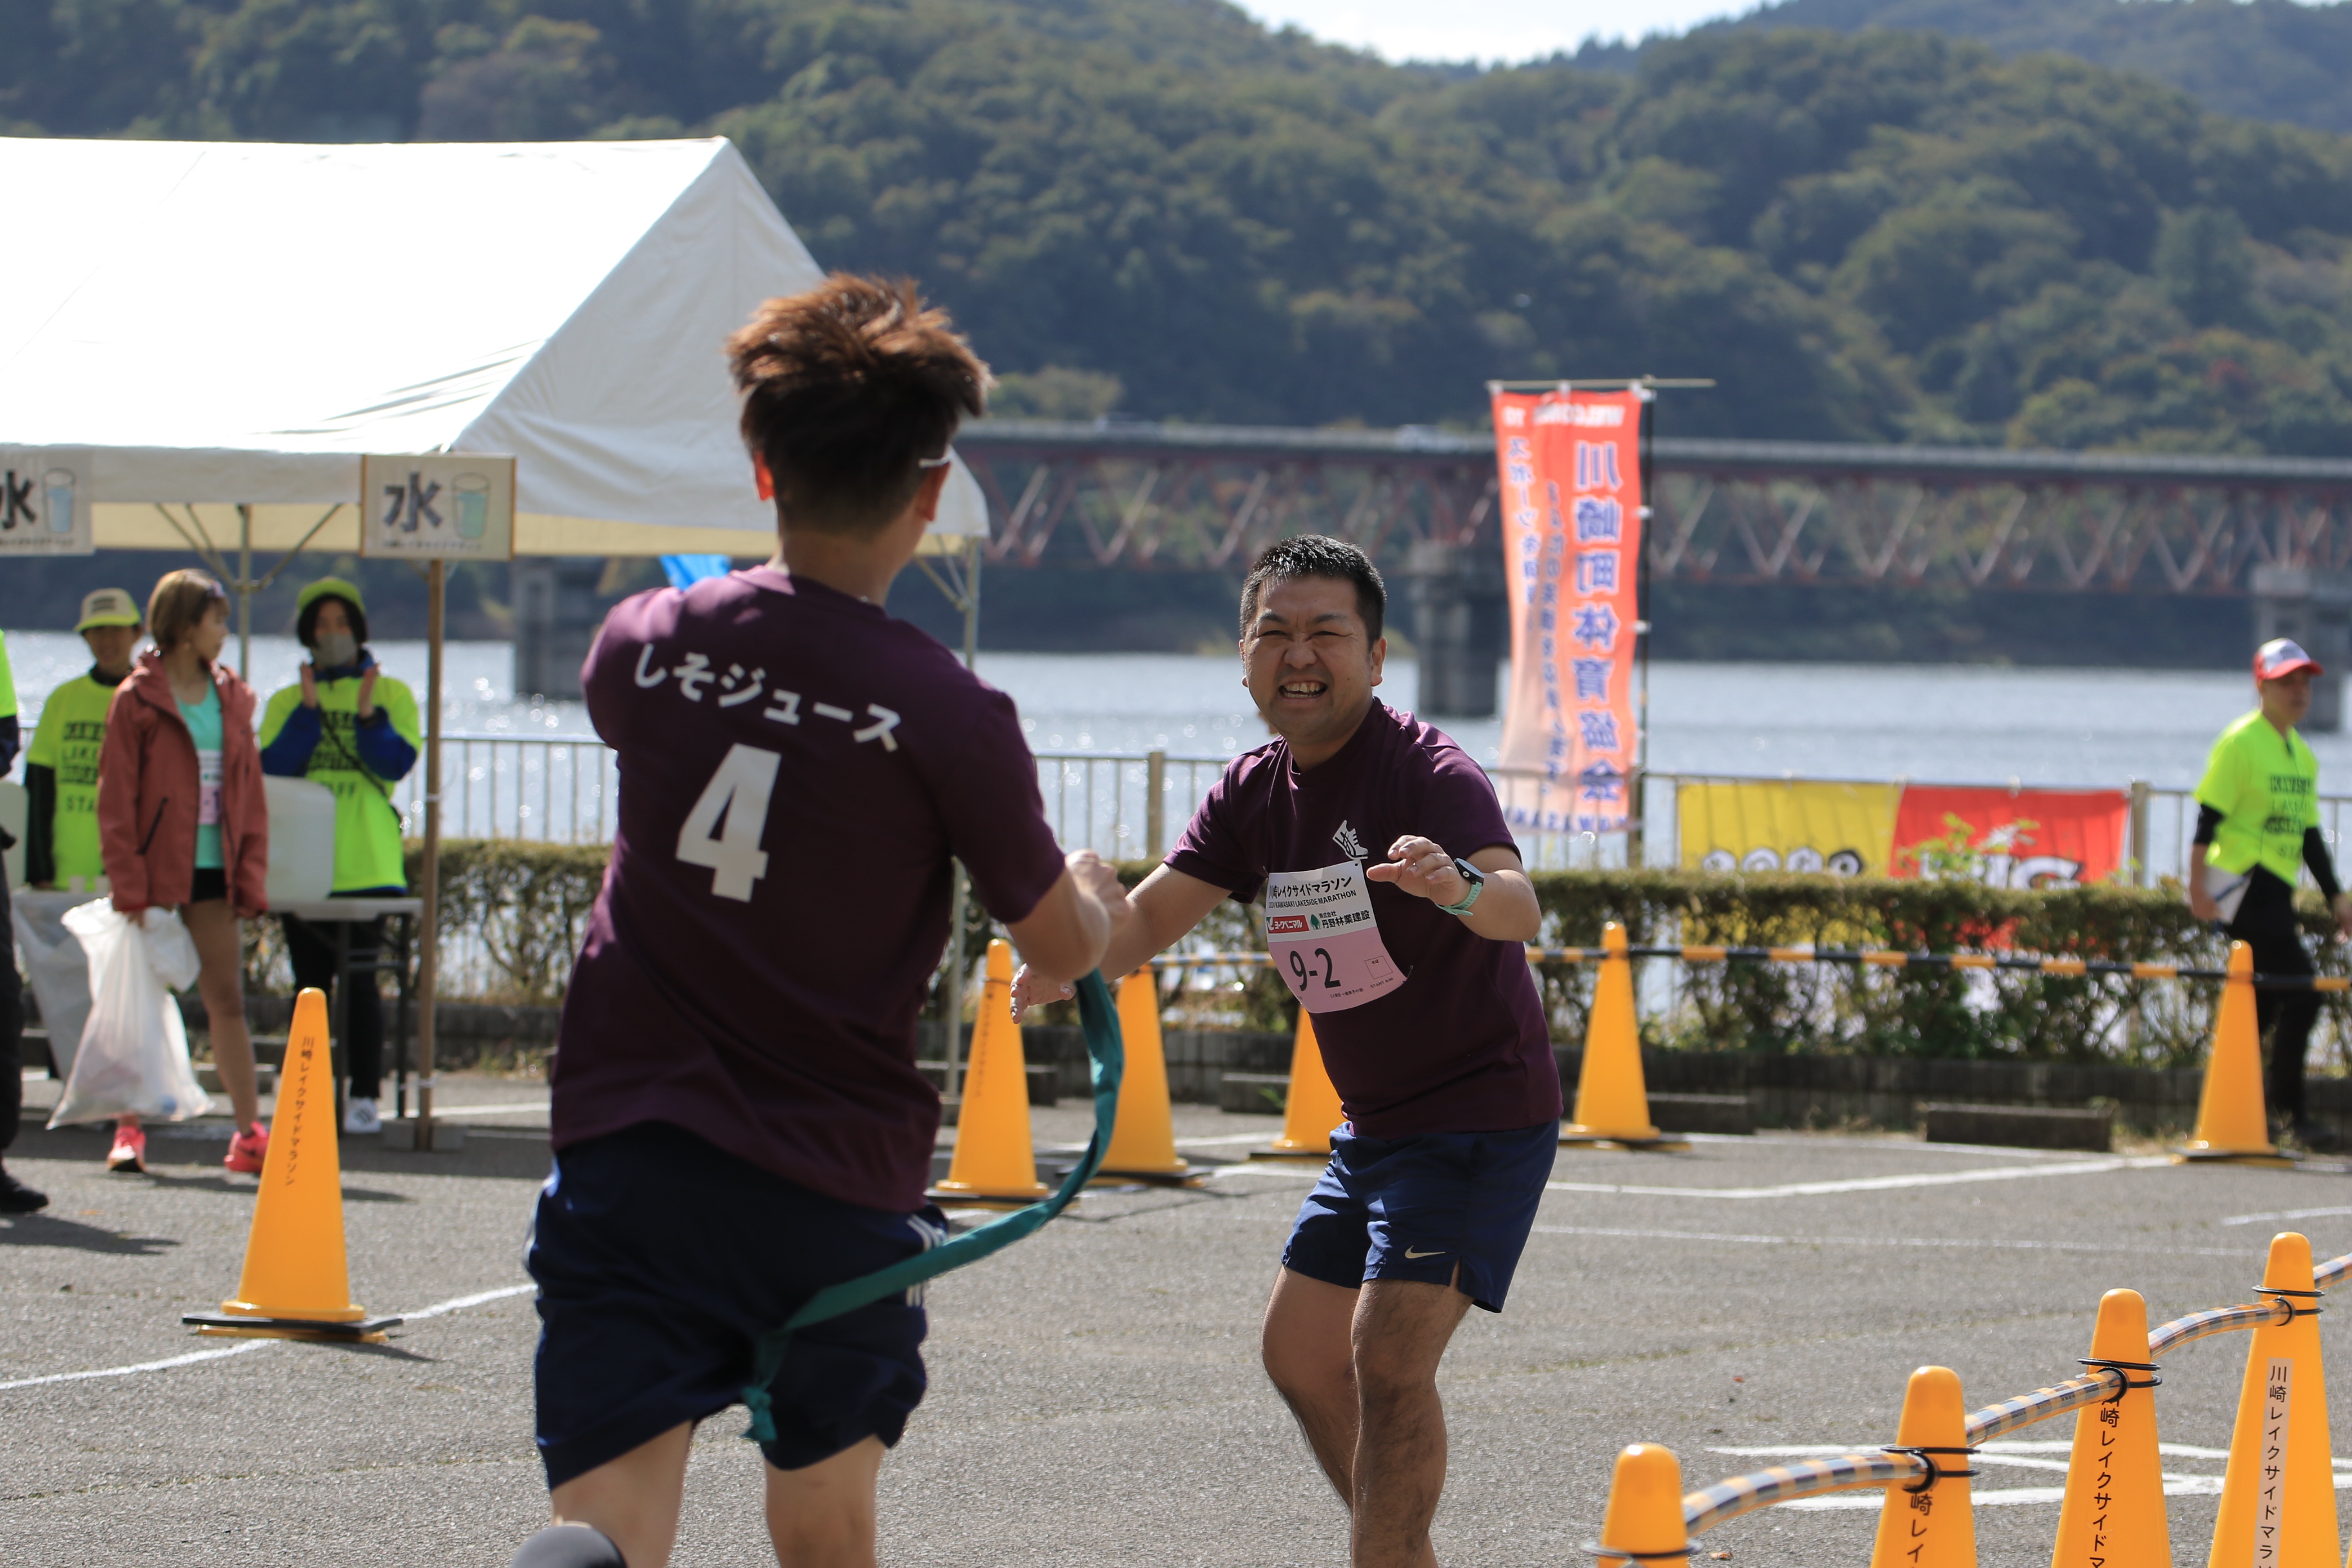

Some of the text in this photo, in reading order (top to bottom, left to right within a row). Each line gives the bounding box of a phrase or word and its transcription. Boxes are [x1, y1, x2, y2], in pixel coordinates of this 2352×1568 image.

[383, 471, 444, 533] 水
[634, 643, 901, 752] しそジュース
[676, 743, 781, 903] 4
[1269, 876, 1352, 899] 川崎レイクサイドマラソン
[1295, 898, 1318, 907] LAKESIDE
[1318, 890, 1357, 904] MARATHON
[1274, 919, 1302, 930] ヨークベニマル
[1319, 910, 1337, 919] 株式会社
[1322, 910, 1371, 929] 丹野林業建設
[1289, 947, 1342, 992] 9-2
[285, 1036, 315, 1186] 川崎レイクサイドマラソン
[2259, 1365, 2288, 1568] 川崎レイクサイドマラ
[1907, 1490, 1934, 1568] 崎レイ
